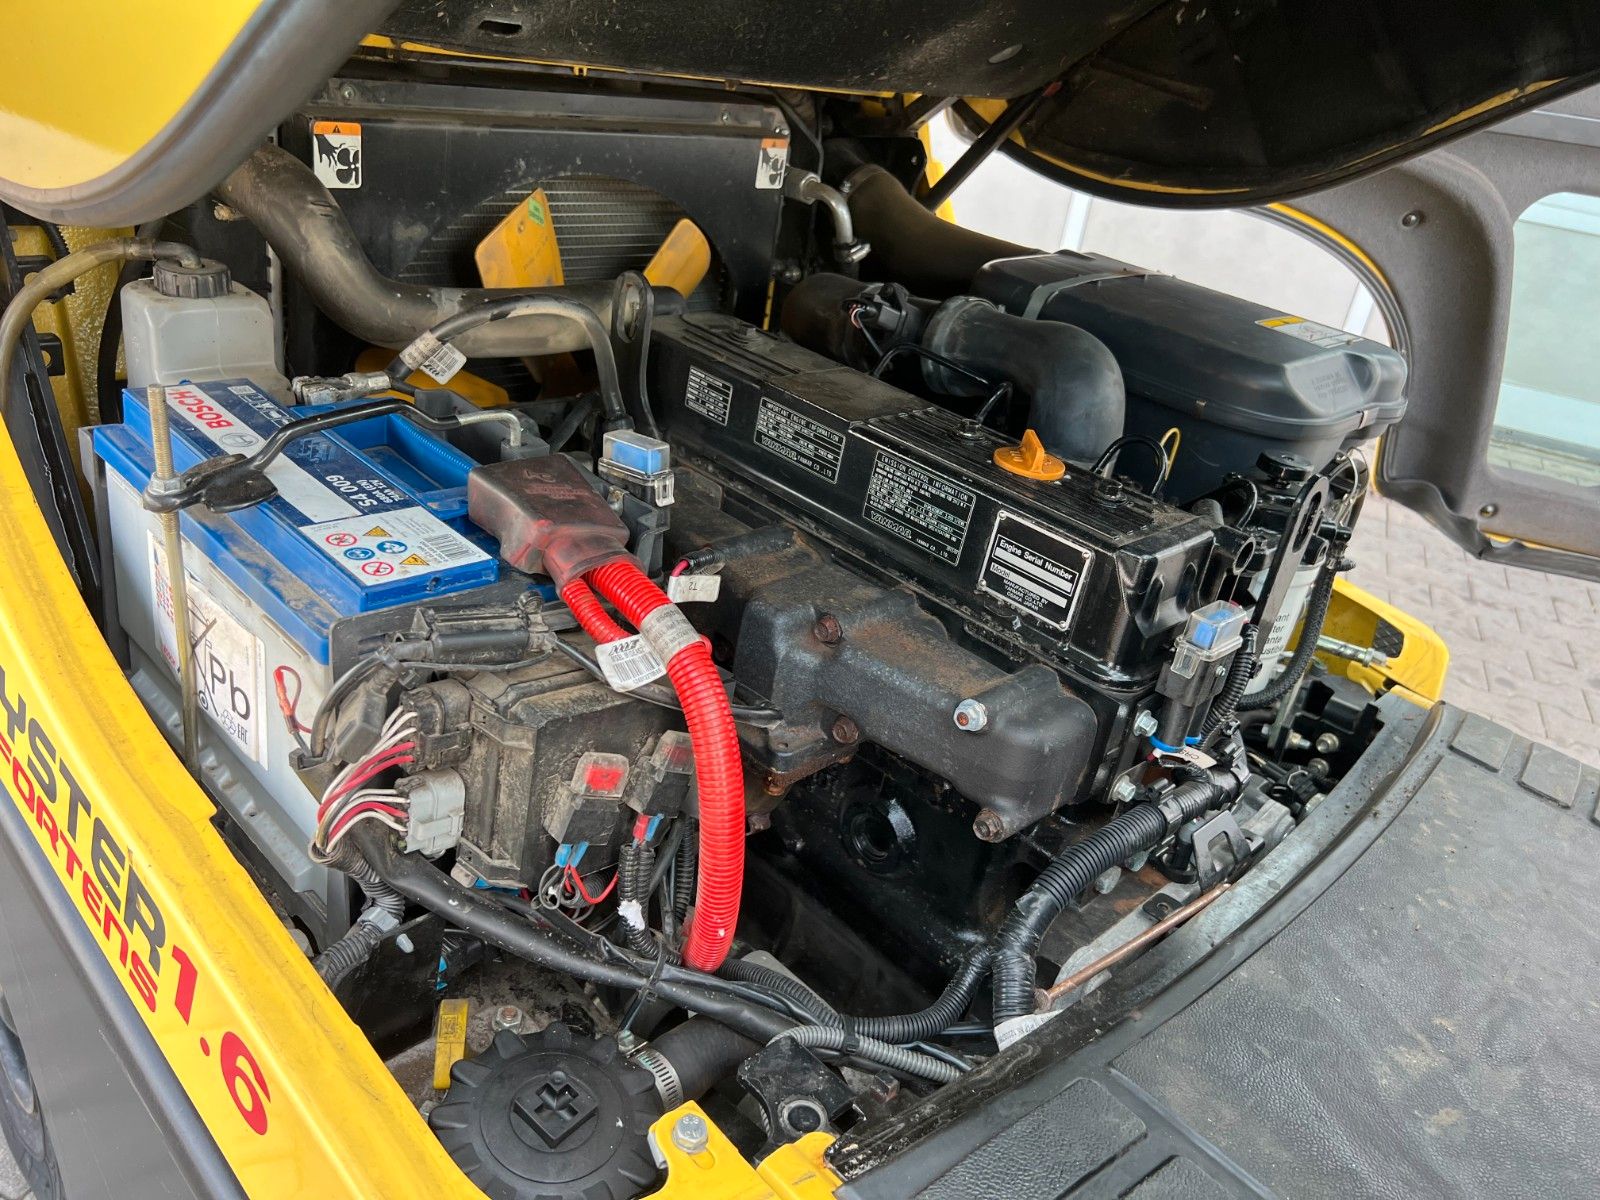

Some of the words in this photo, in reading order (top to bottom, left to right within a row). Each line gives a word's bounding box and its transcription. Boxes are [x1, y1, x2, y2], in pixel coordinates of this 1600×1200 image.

[168, 389, 234, 430] BOSCH
[765, 402, 790, 417] IMPORTANT
[790, 414, 807, 427] ENGINE
[808, 423, 840, 442] INFORMATION
[325, 474, 359, 493] 009
[881, 455, 906, 472] EMISSION
[907, 468, 929, 484] CONTROL
[932, 480, 969, 502] INFORMATION
[349, 493, 378, 507] S4
[991, 564, 1011, 578] Model
[1000, 539, 1022, 556] Engine
[1023, 551, 1044, 565] Serial
[1045, 561, 1073, 580] Number
[1003, 578, 1041, 601] MANUFACTURED
[1004, 585, 1024, 598] YANMAR
[1023, 600, 1039, 611] JAPAN
[209, 652, 251, 721] Pb
[172, 944, 272, 1137] 1.6
